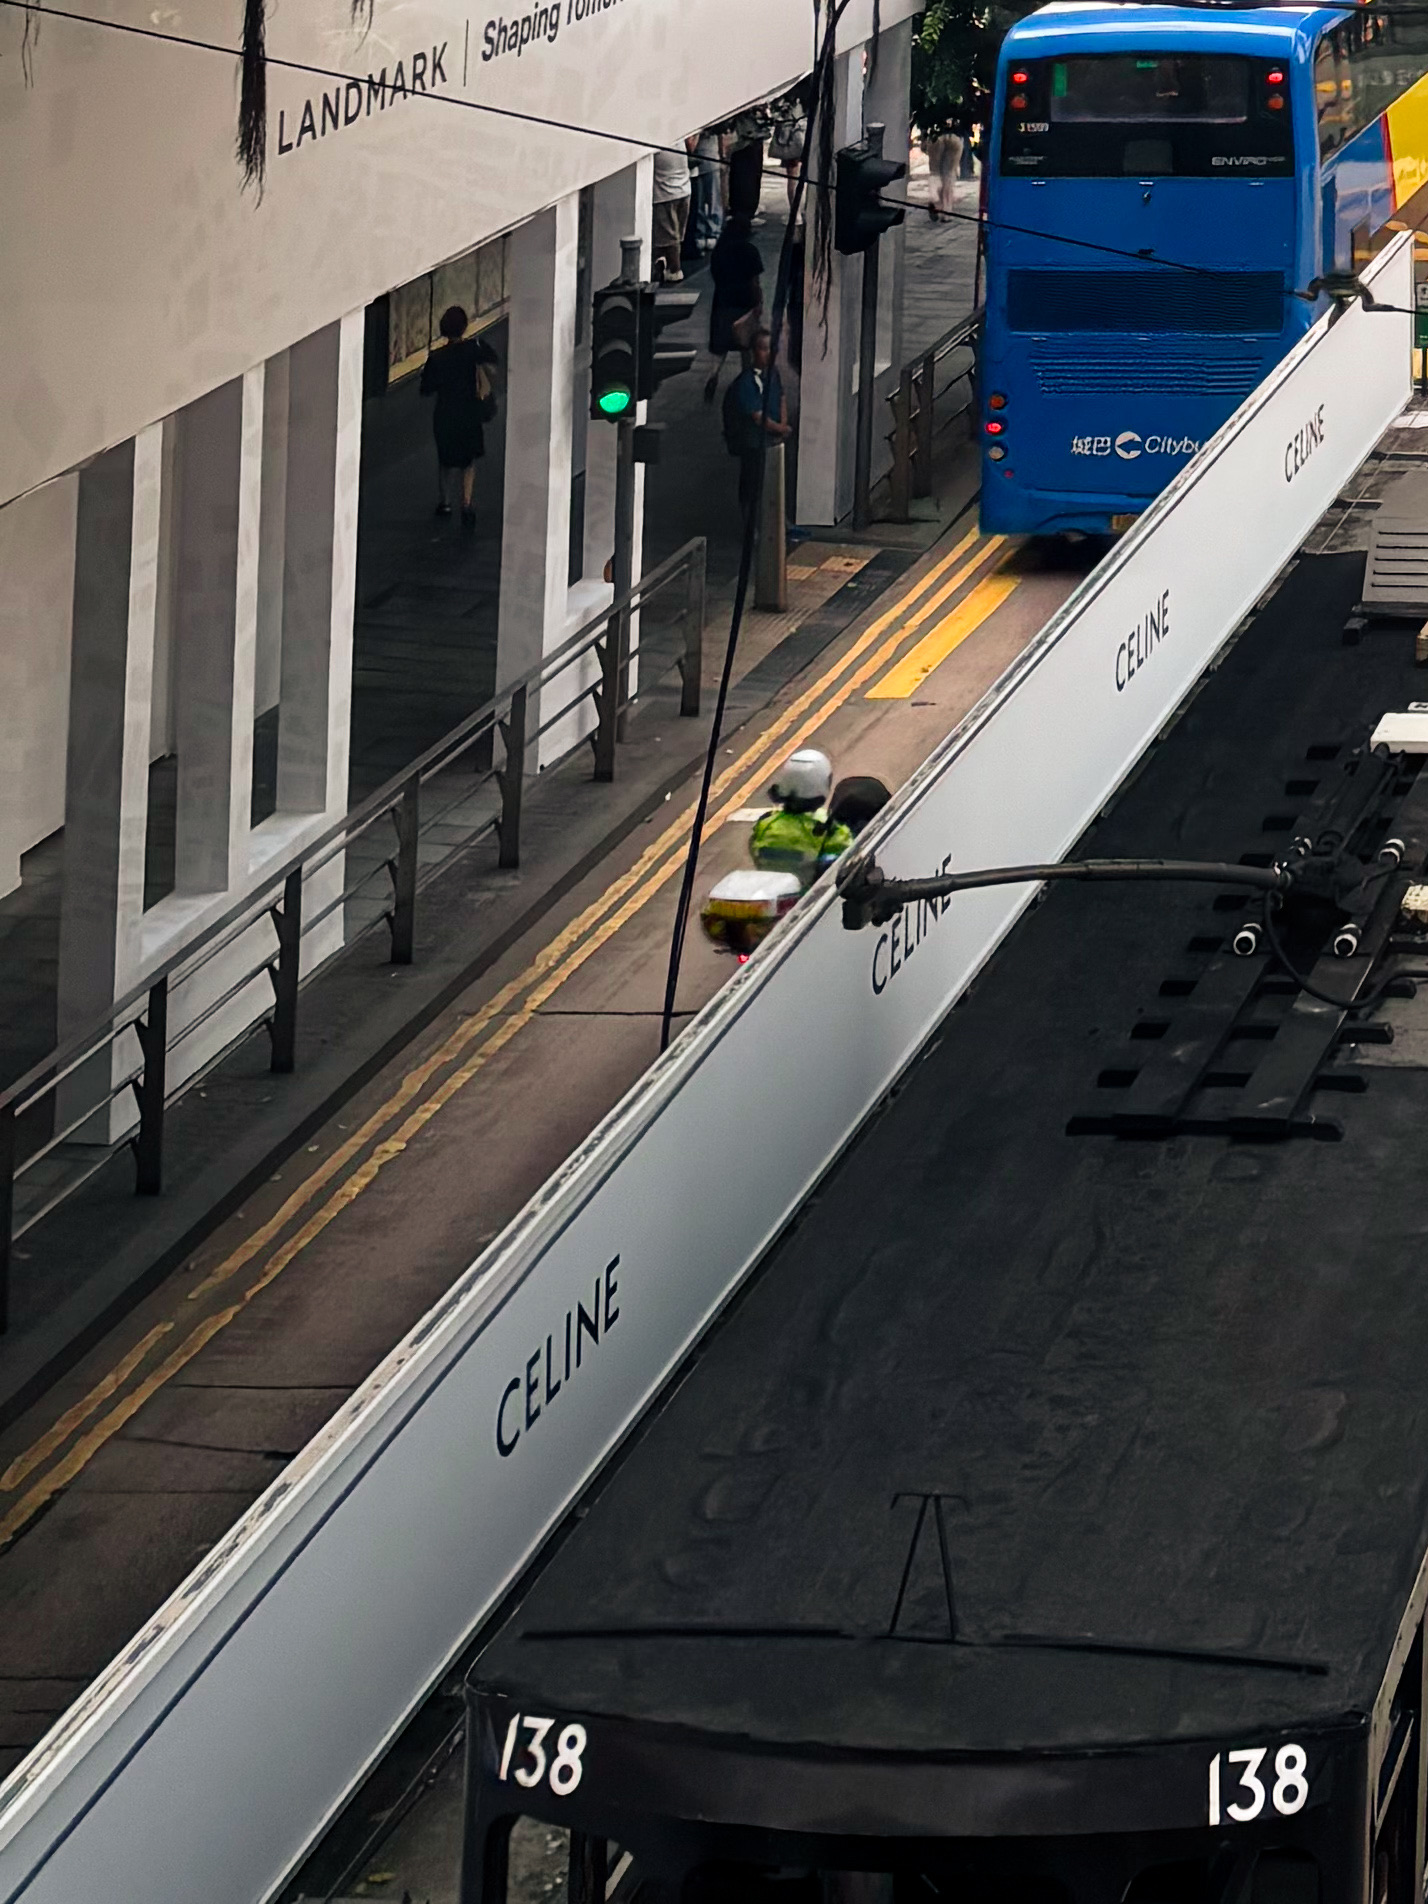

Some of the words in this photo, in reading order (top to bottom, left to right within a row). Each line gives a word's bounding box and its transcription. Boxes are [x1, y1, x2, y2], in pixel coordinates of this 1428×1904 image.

[277, 41, 448, 155] LANDMARK
[481, 1, 561, 62] Shaping
[1145, 435, 1199, 456] Cityb
[1285, 403, 1324, 482] CELINE
[1116, 589, 1169, 692] CELINE
[872, 853, 952, 995] CELINE
[495, 1254, 621, 1458] CELINE
[499, 1712, 587, 1796] 138
[1209, 1743, 1309, 1827] 138
